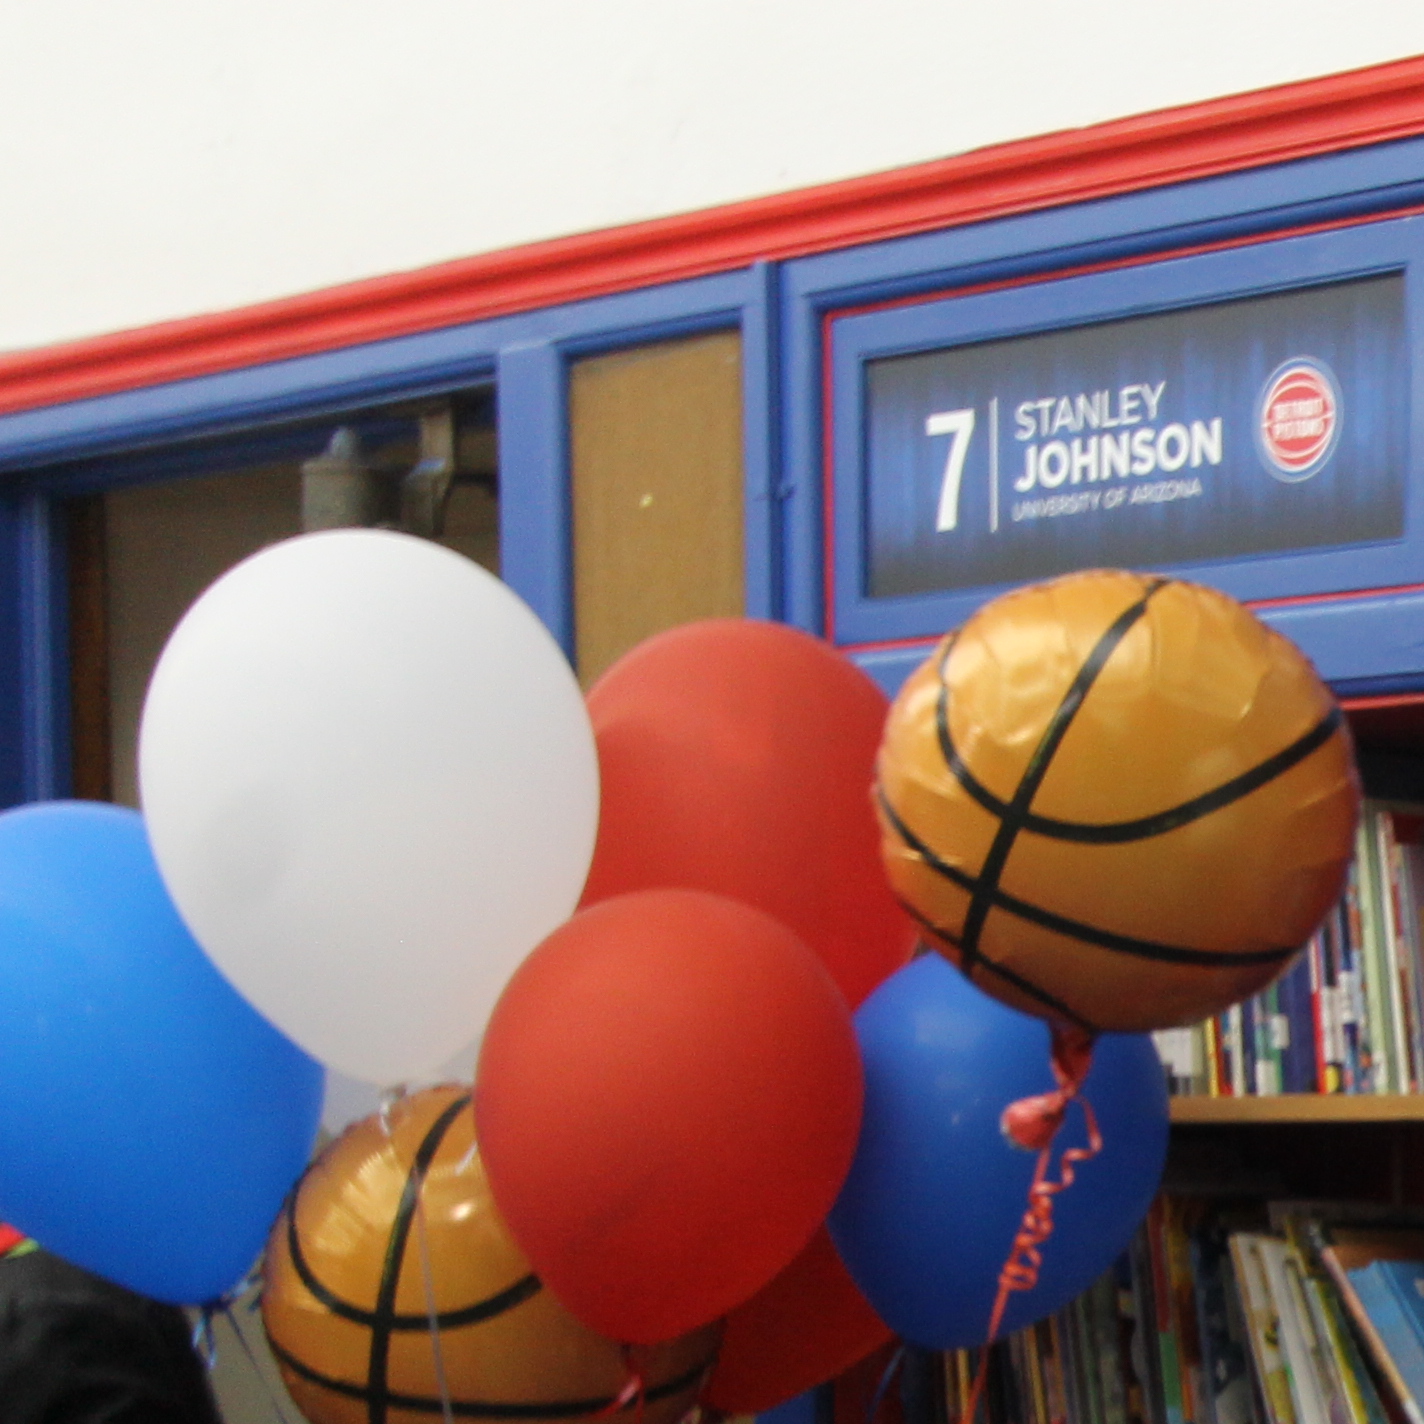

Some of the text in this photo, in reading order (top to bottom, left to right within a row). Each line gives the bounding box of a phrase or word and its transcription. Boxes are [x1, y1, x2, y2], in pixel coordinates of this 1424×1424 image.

[1014, 381, 1166, 441] STANLEY
[926, 409, 975, 532] 7
[1013, 417, 1222, 492] JOHNSON
[1012, 477, 1202, 521] UNIVERSITY OF ARIZONA
